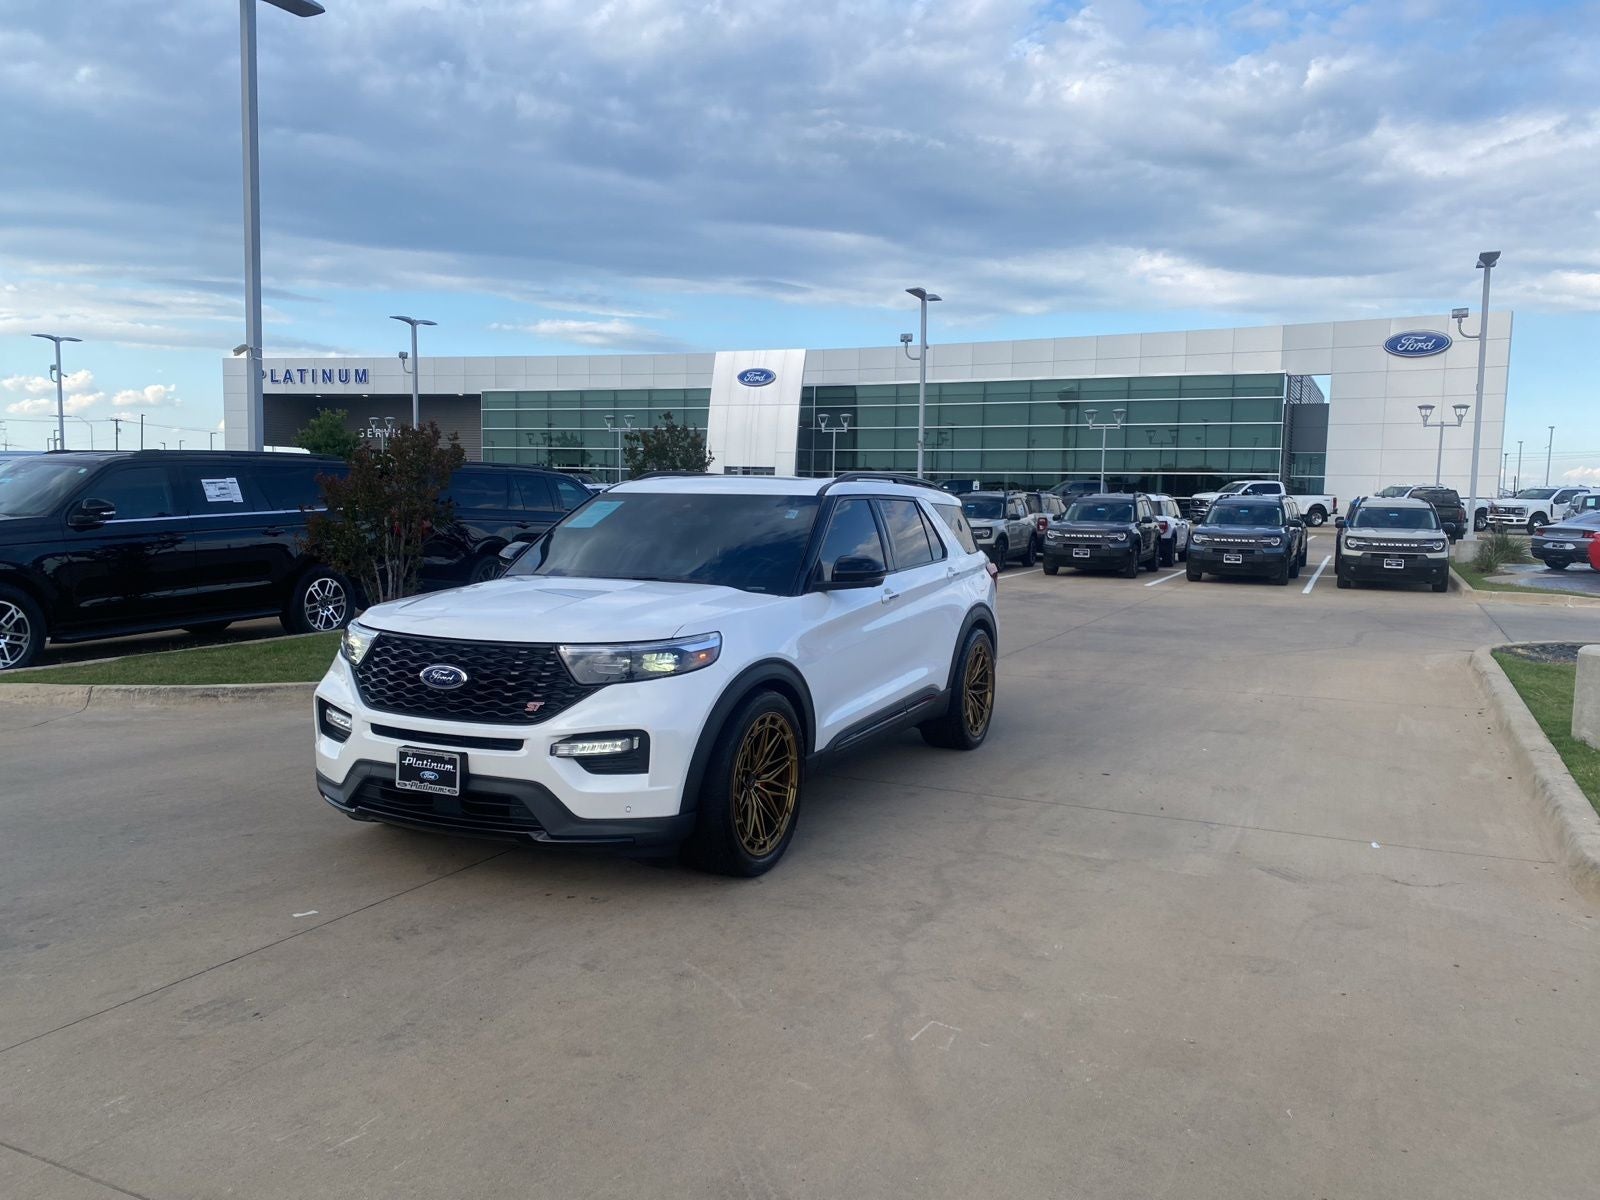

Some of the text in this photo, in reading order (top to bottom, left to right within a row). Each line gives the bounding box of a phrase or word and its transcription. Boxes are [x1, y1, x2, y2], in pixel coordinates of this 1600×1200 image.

[1397, 336, 1436, 351] Ford
[744, 371, 766, 382] Ford
[359, 428, 412, 438] SERVI
[430, 669, 454, 682] Ford
[524, 701, 545, 712] ST
[401, 756, 456, 772] Platinum
